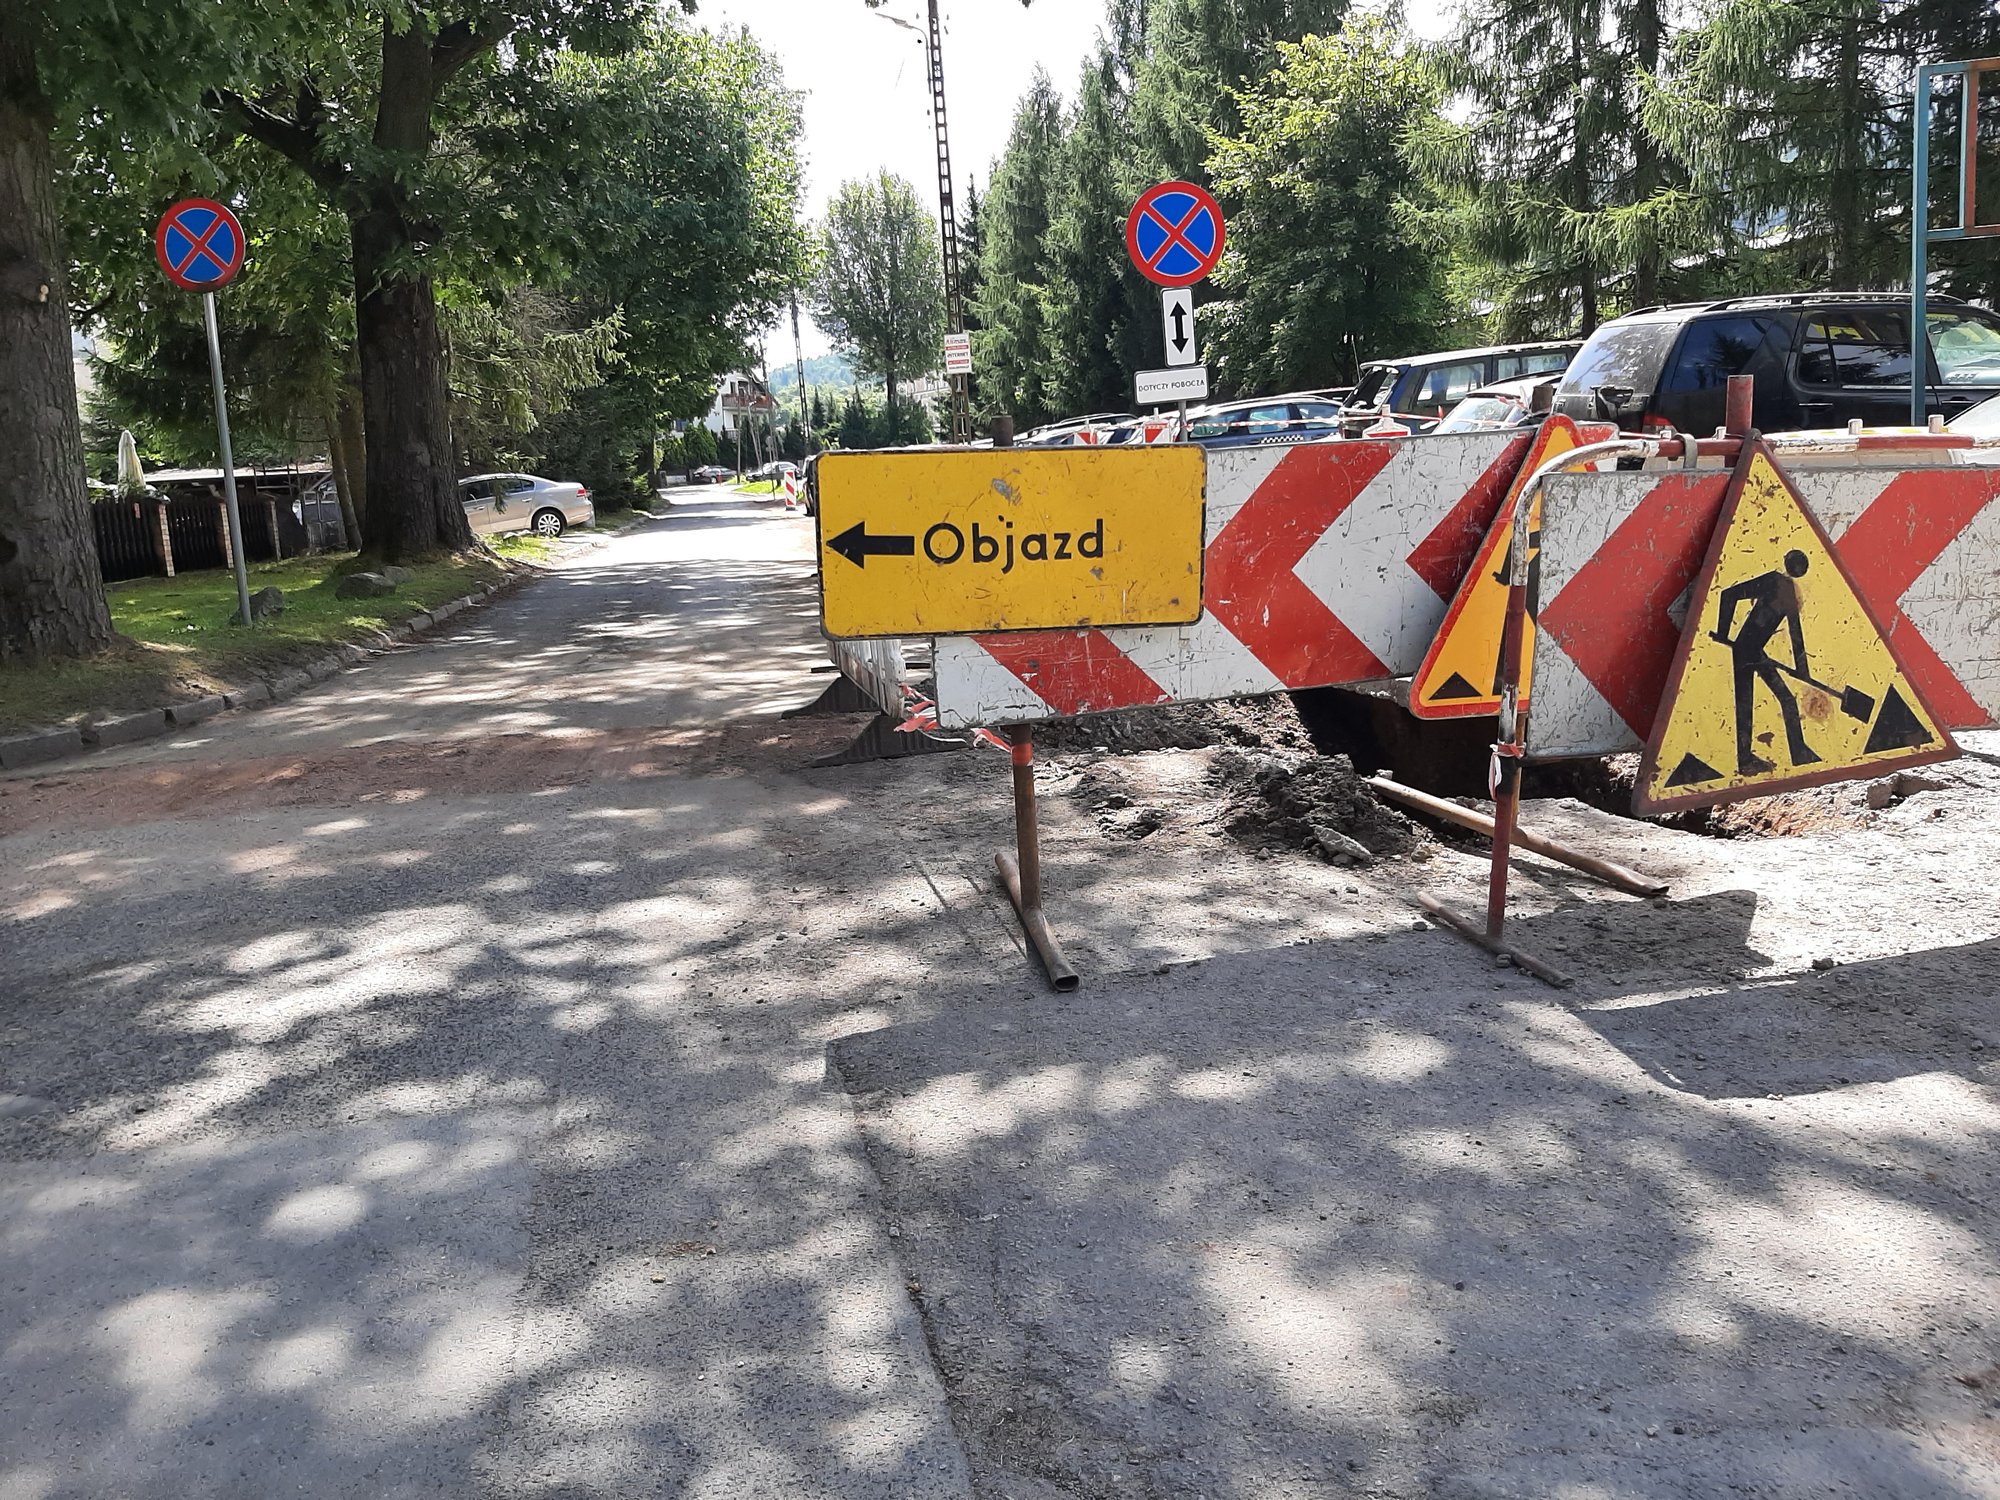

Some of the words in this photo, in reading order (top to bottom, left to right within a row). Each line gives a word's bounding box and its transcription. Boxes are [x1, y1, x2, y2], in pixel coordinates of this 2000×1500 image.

[1138, 383, 1169, 392] DOTYCZY
[1171, 379, 1205, 389] POBOCZA
[923, 518, 1103, 574] Objazd
